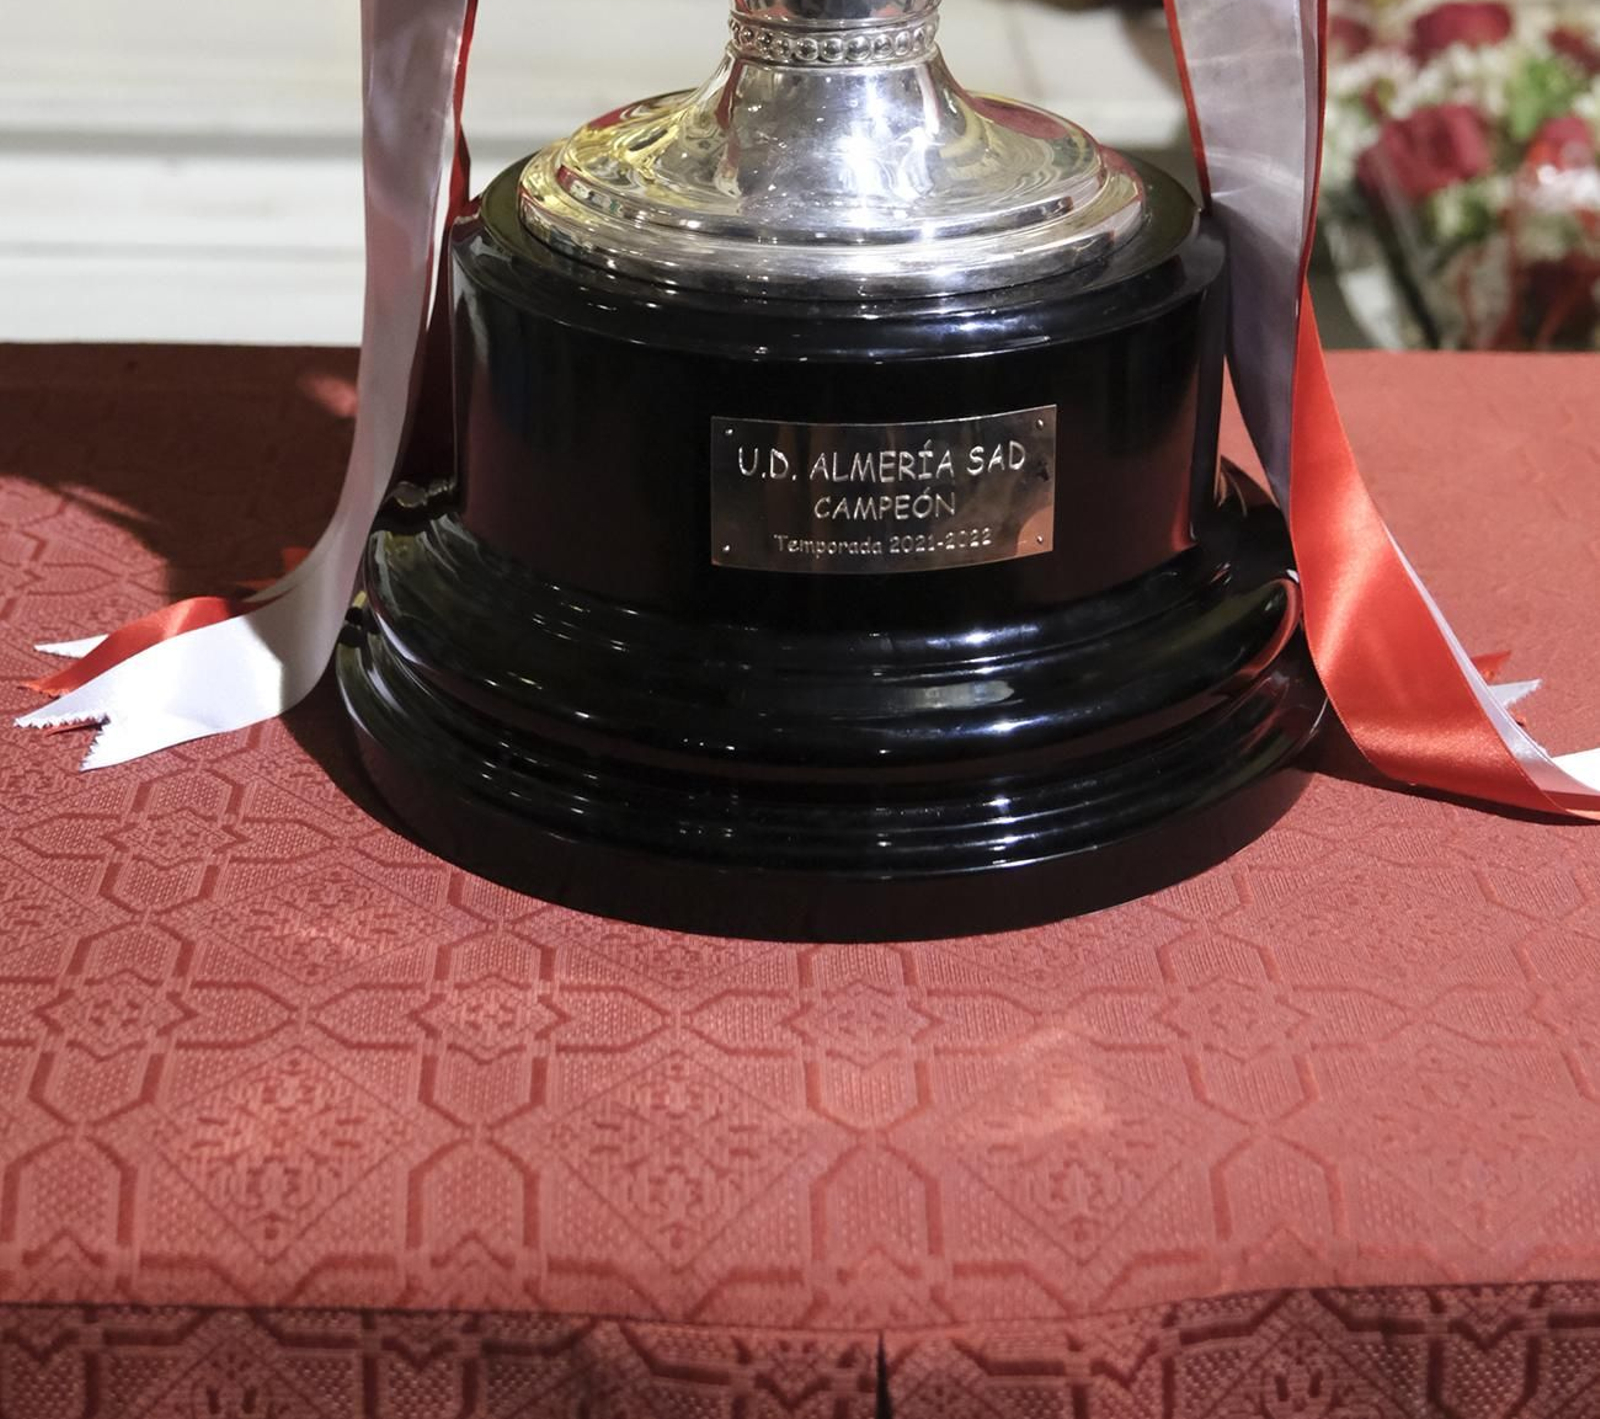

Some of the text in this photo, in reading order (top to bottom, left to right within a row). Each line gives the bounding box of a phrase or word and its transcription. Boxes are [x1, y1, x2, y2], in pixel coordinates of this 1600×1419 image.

[738, 439, 1026, 483] U.D. ALMERÍA SAD
[814, 487, 956, 520] CAMPEÓN
[773, 527, 992, 559] Temporada 2021-2022
